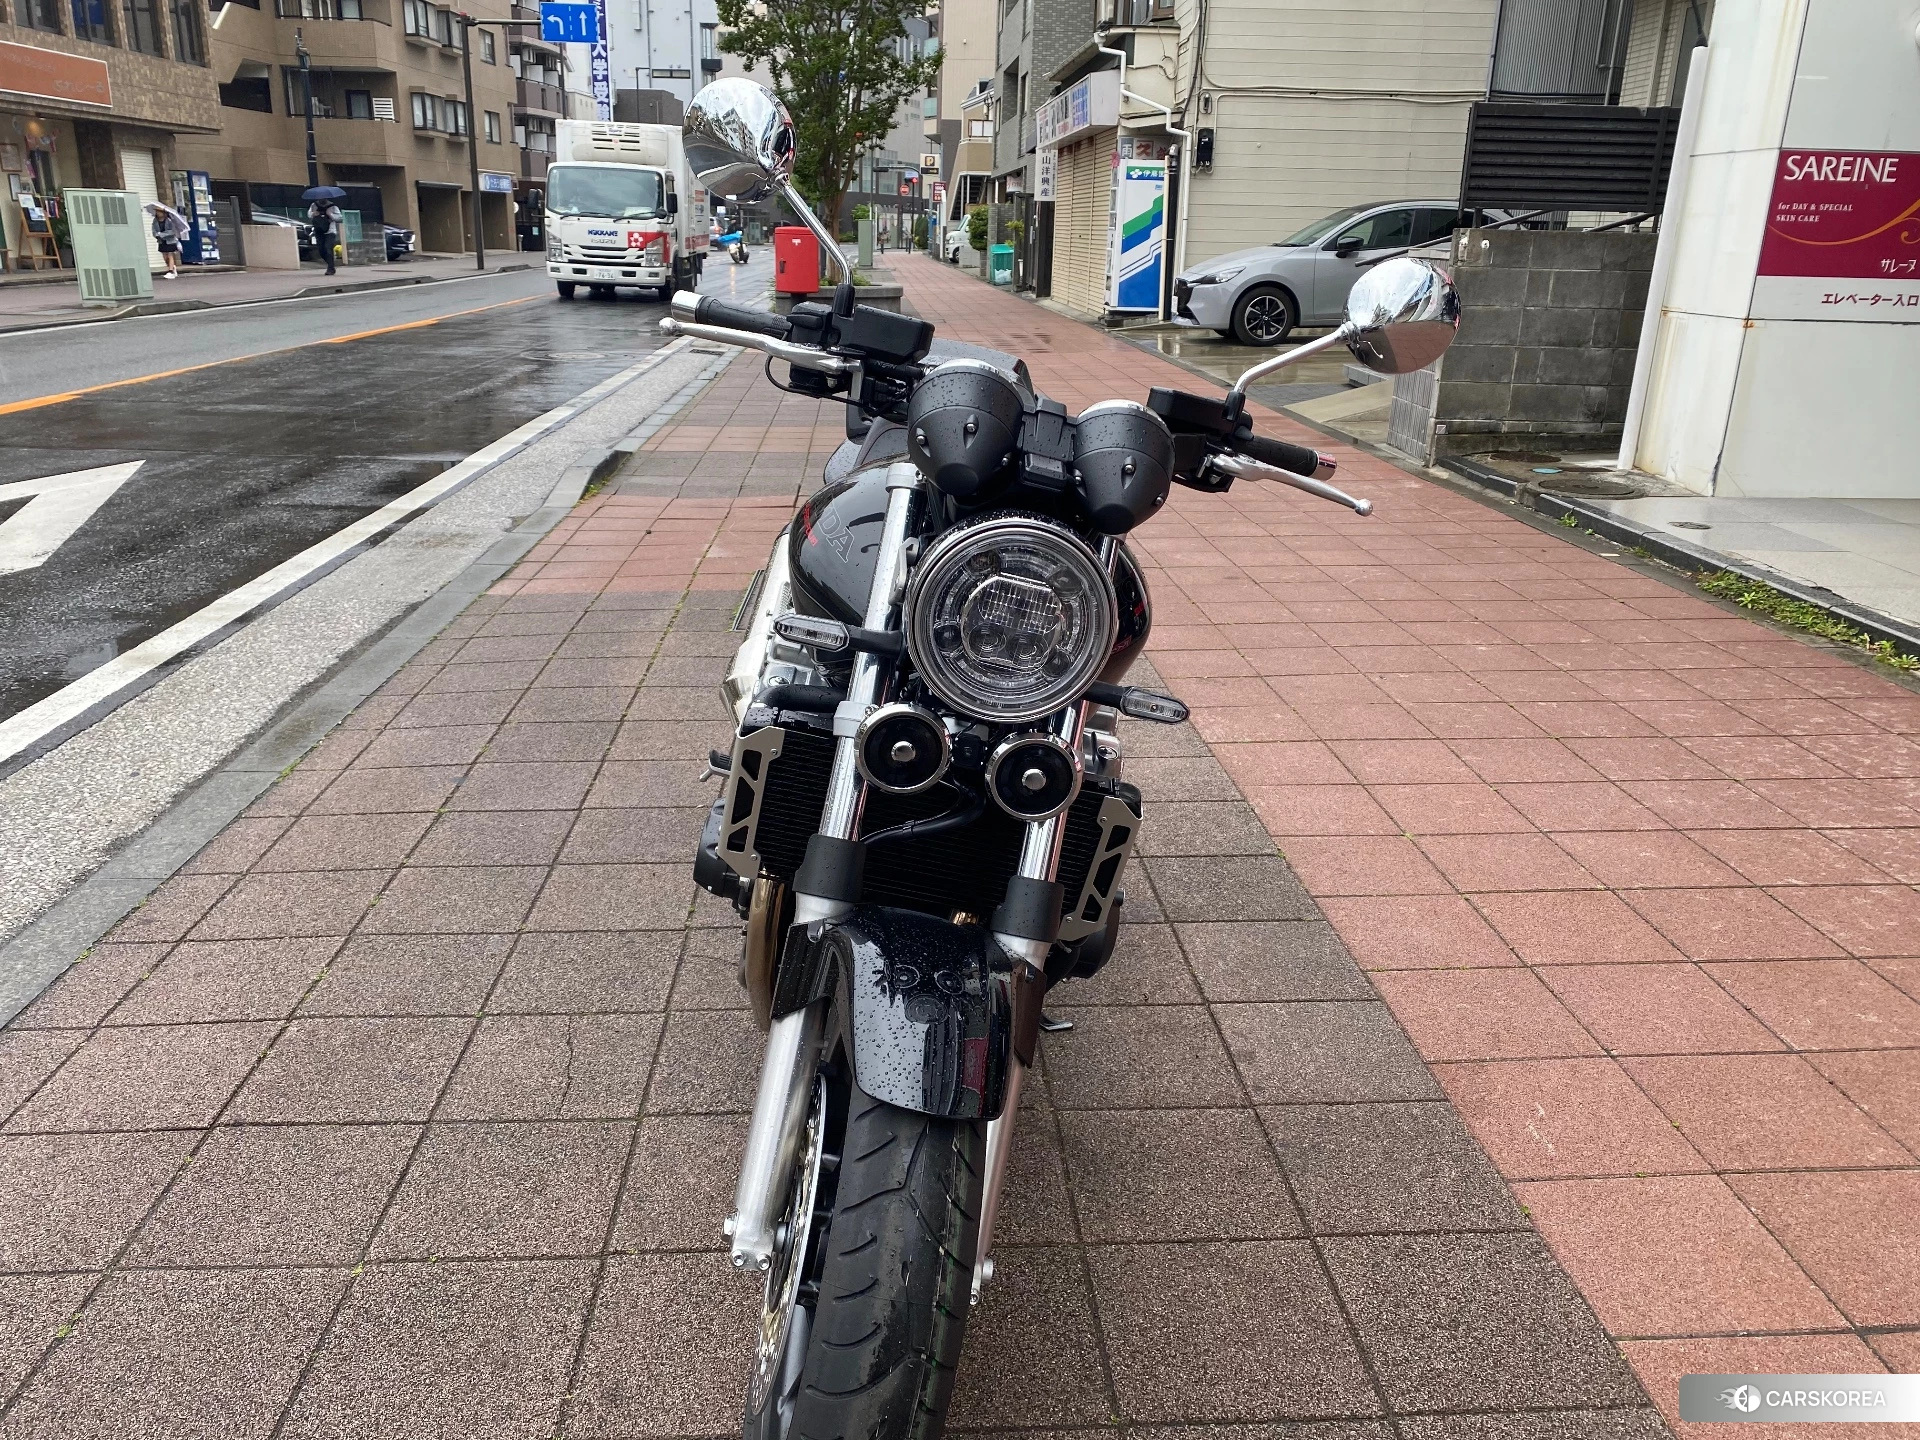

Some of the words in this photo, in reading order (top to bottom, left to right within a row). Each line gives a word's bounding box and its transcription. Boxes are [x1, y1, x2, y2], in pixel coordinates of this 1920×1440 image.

[1783, 155, 1899, 183] SAREINE
[1777, 202, 1790, 210] for
[1792, 203, 1809, 211] DAY
[1810, 203, 1816, 211] &
[1819, 203, 1854, 211] SPECIAL
[1776, 214, 1796, 222] SKIN
[1880, 258, 1917, 273] サレーヌ
[1821, 293, 1920, 307] エレベーター入口
